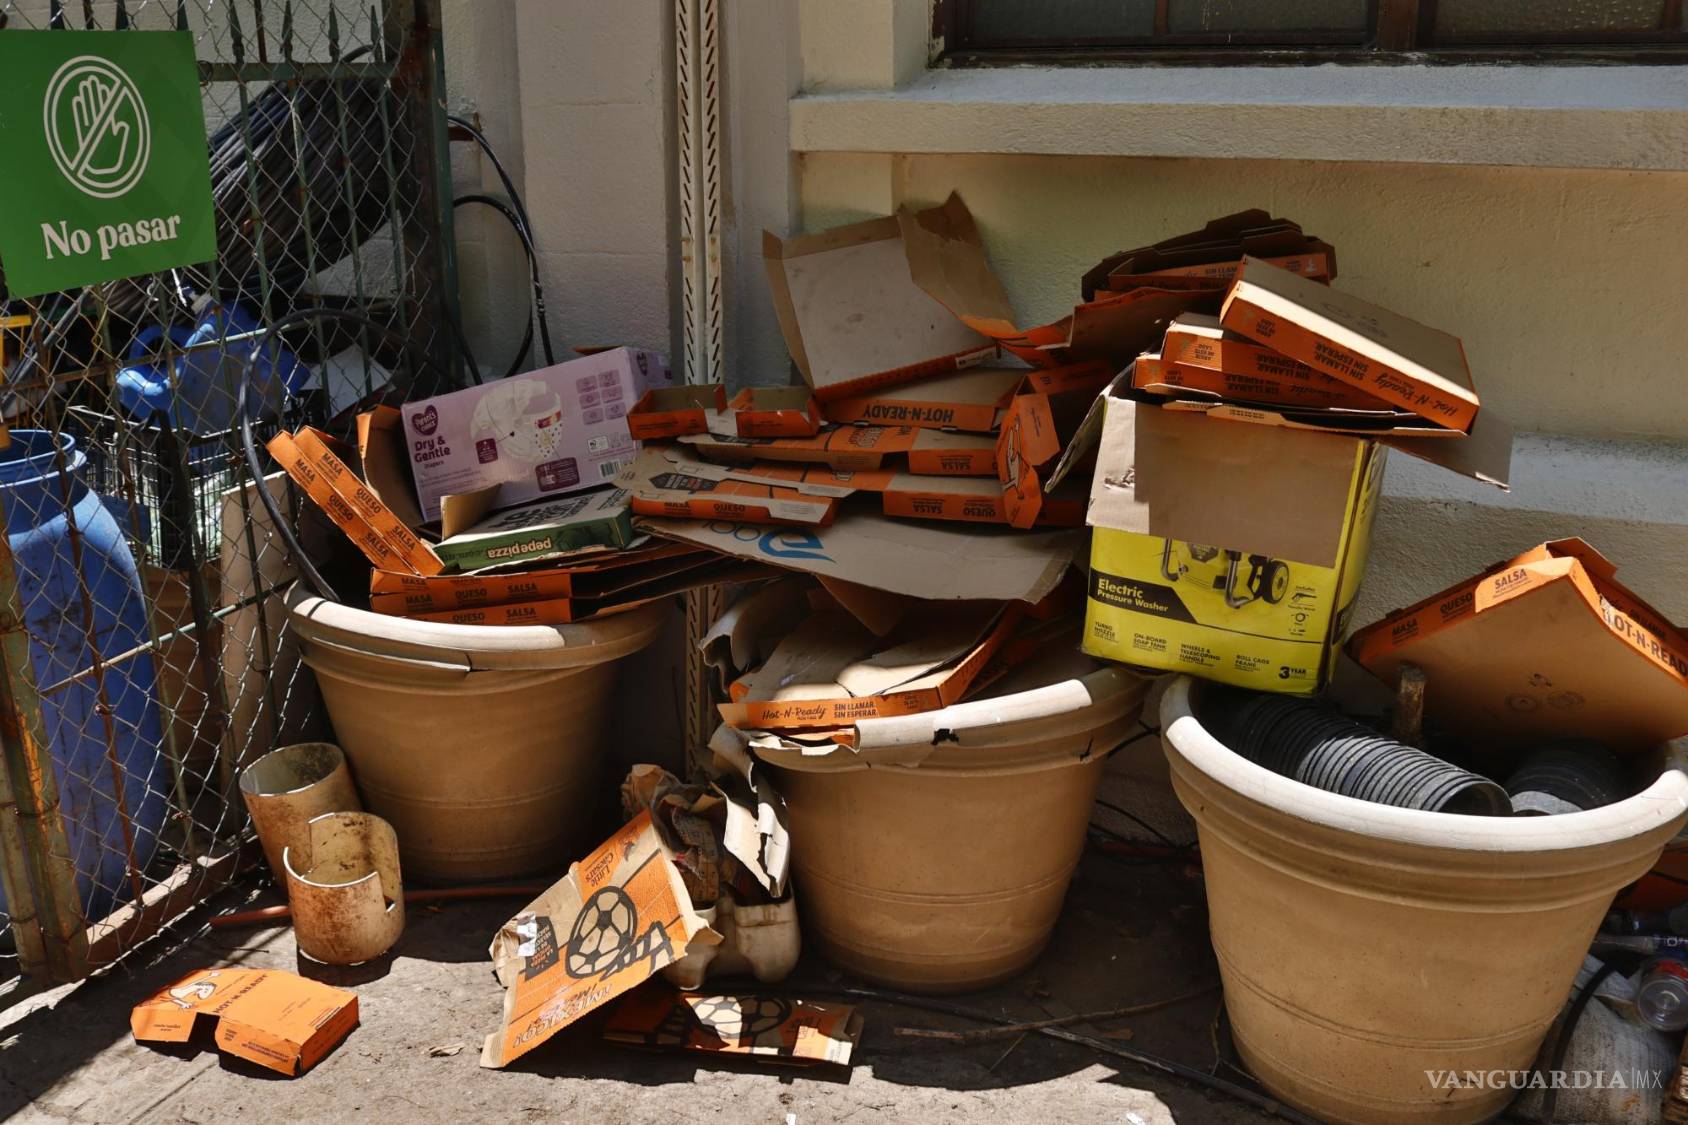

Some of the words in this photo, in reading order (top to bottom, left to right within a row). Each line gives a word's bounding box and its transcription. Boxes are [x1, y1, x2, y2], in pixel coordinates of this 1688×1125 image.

[41, 220, 92, 259] No
[97, 215, 181, 260] pasar
[1350, 368, 1365, 381] SIN
[1354, 360, 1369, 372] SIN
[1374, 372, 1457, 417] Hot-N-Ready
[863, 404, 954, 423] HOT-N-READY
[415, 439, 435, 452] Dry
[437, 435, 446, 446] &
[414, 447, 451, 463] Gentle
[940, 459, 971, 470] SALSA
[295, 458, 316, 482] MASA
[329, 495, 354, 521] QUESO
[365, 532, 389, 558] SALSA
[321, 453, 343, 477] MASA
[356, 488, 382, 515] QUESO
[392, 526, 416, 551] SALSA
[713, 503, 746, 513] QUESO
[913, 501, 944, 513] SALSA
[963, 506, 996, 518] QUESO
[402, 577, 427, 586] MASA
[1098, 578, 1144, 599] Electric
[406, 594, 433, 604] MASA
[455, 588, 488, 600] QUESO
[507, 582, 537, 593] SALSA
[1097, 589, 1133, 605] Pressure
[1135, 599, 1169, 613] Washer
[1391, 619, 1419, 637] MASA
[1440, 592, 1473, 615] QUESO
[1494, 568, 1528, 591] SALSA
[452, 612, 485, 624] QUESO
[506, 608, 536, 618] SALSA
[1601, 607, 1688, 677] OT-N-READ
[1278, 666, 1290, 680] 3
[762, 704, 827, 721] Hot-N-Ready
[833, 711, 846, 719] SIN
[586, 852, 614, 881] Caesars
[591, 864, 610, 886] Little
